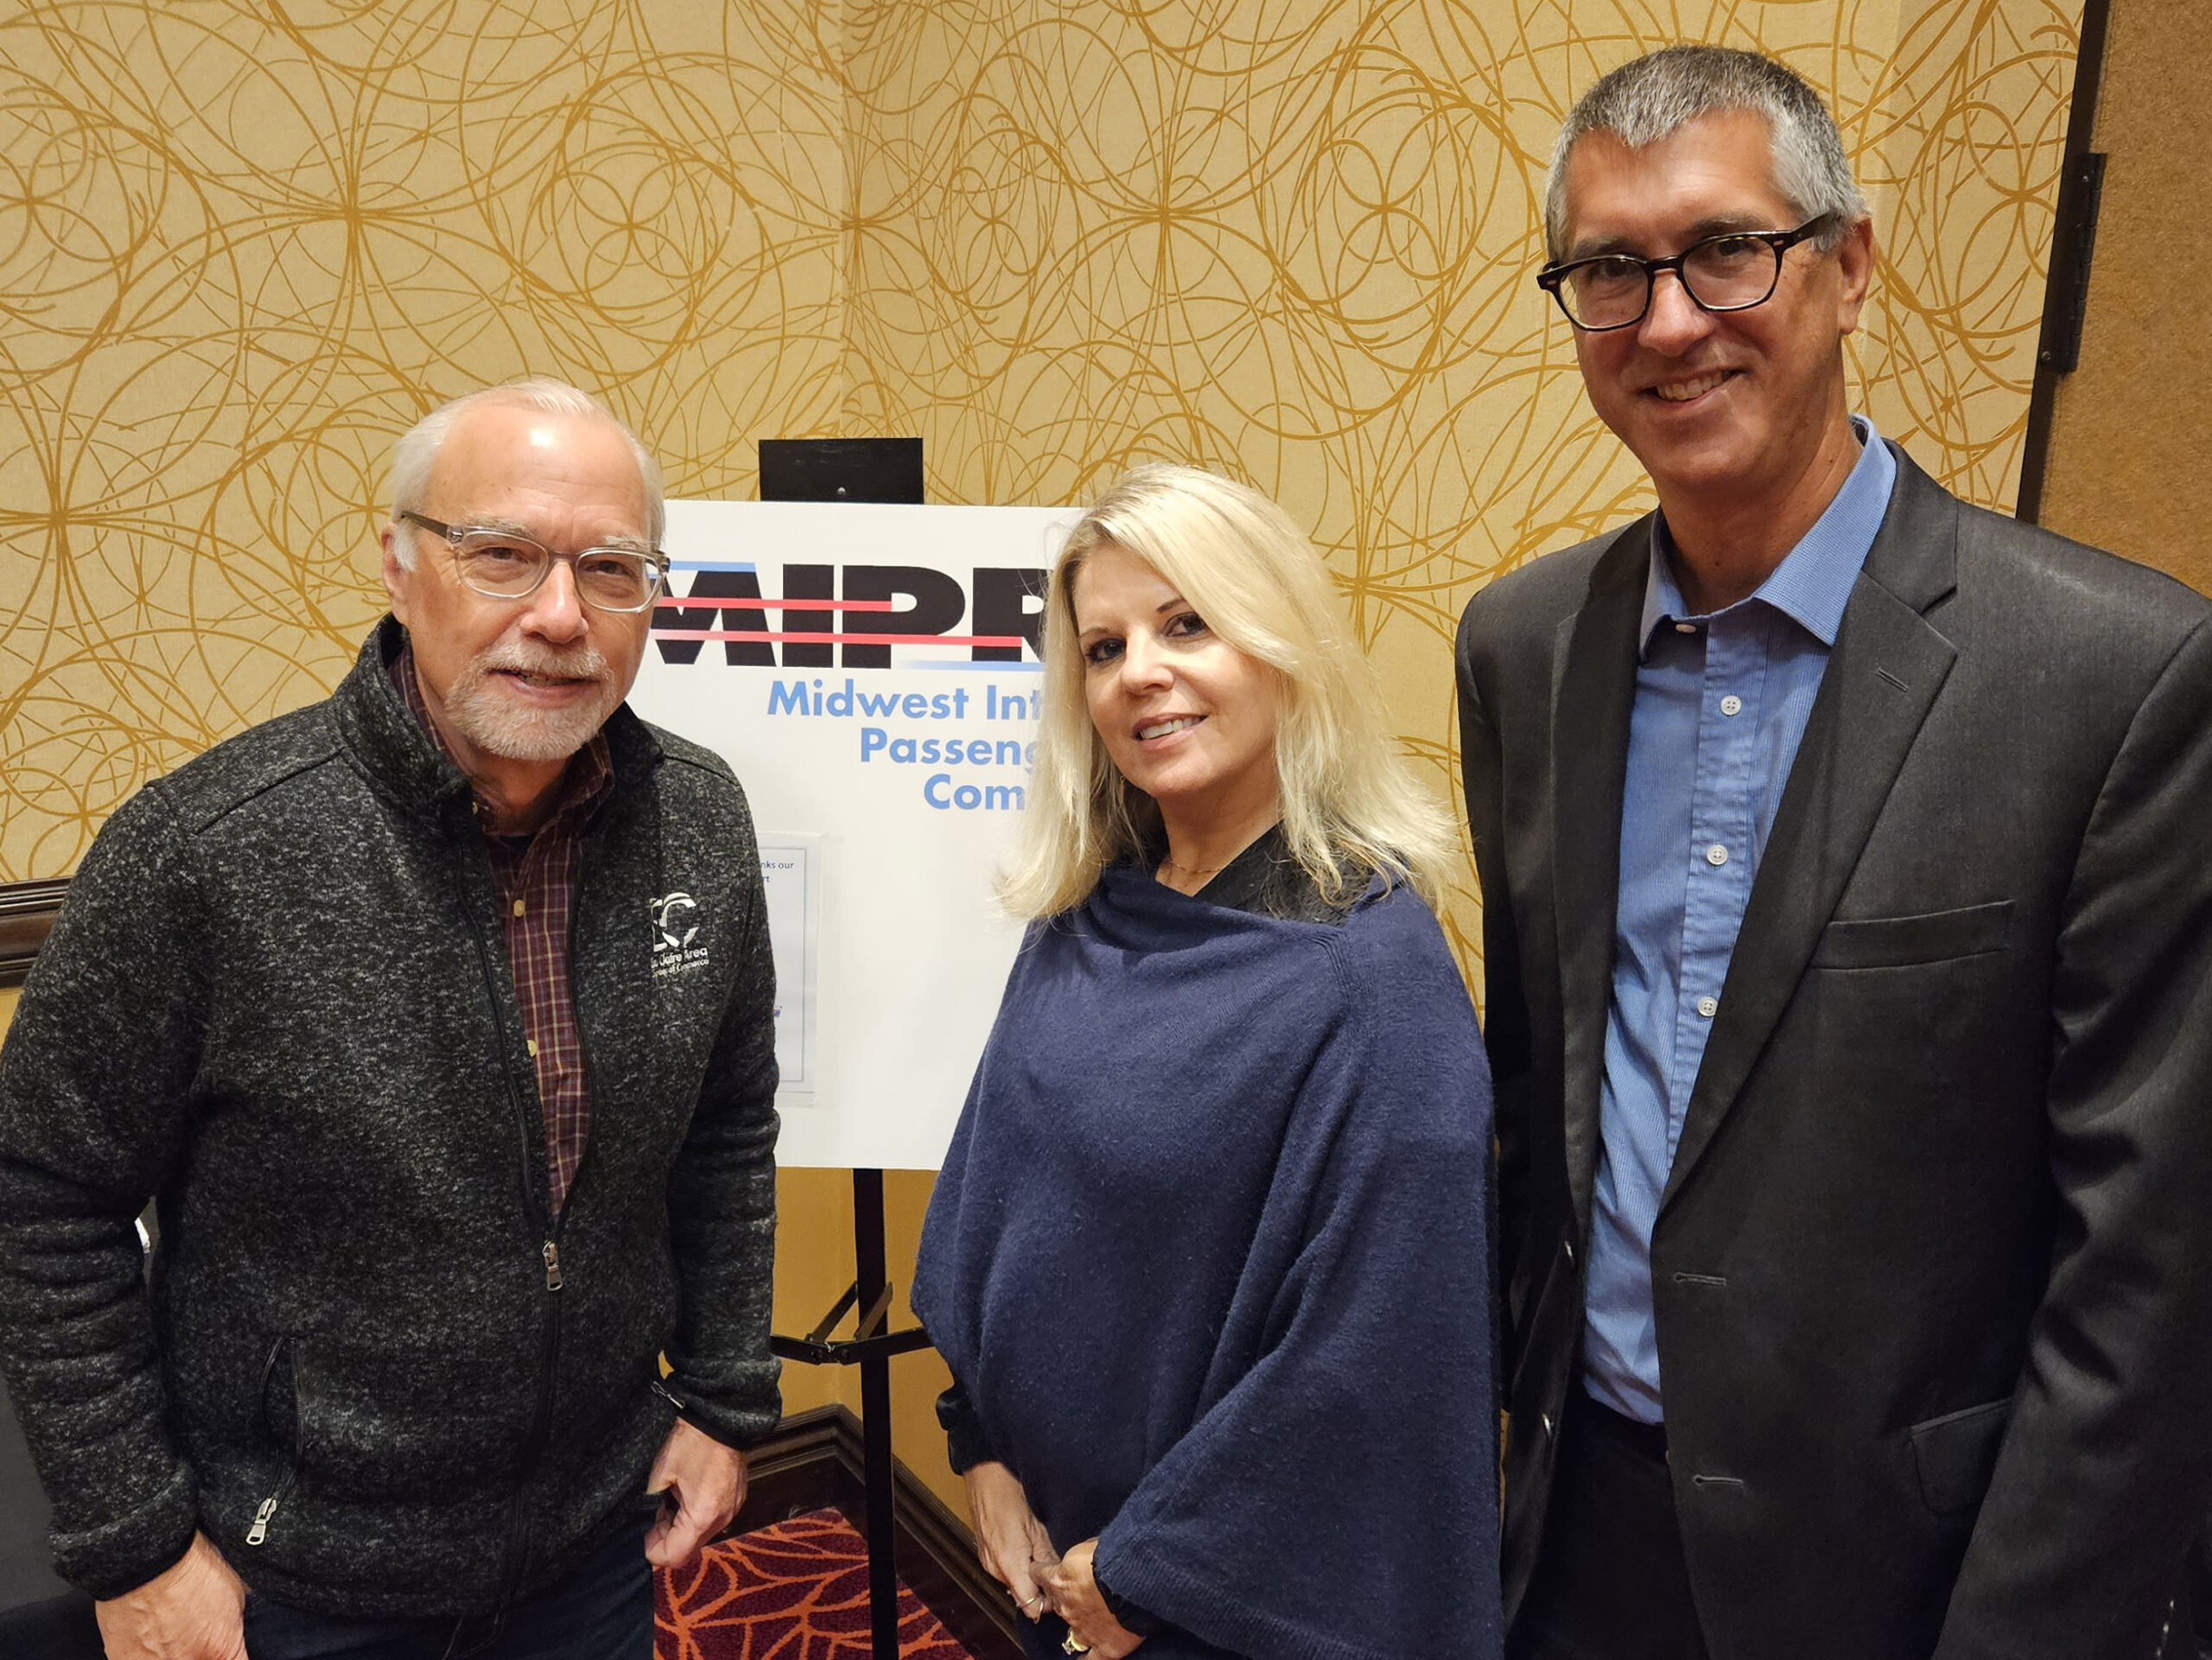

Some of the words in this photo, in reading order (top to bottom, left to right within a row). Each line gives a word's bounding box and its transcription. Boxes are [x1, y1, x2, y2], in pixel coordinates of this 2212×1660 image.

[767, 678, 969, 720] Midwest
[924, 773, 1026, 811] Com
[683, 947, 709, 961] Area
